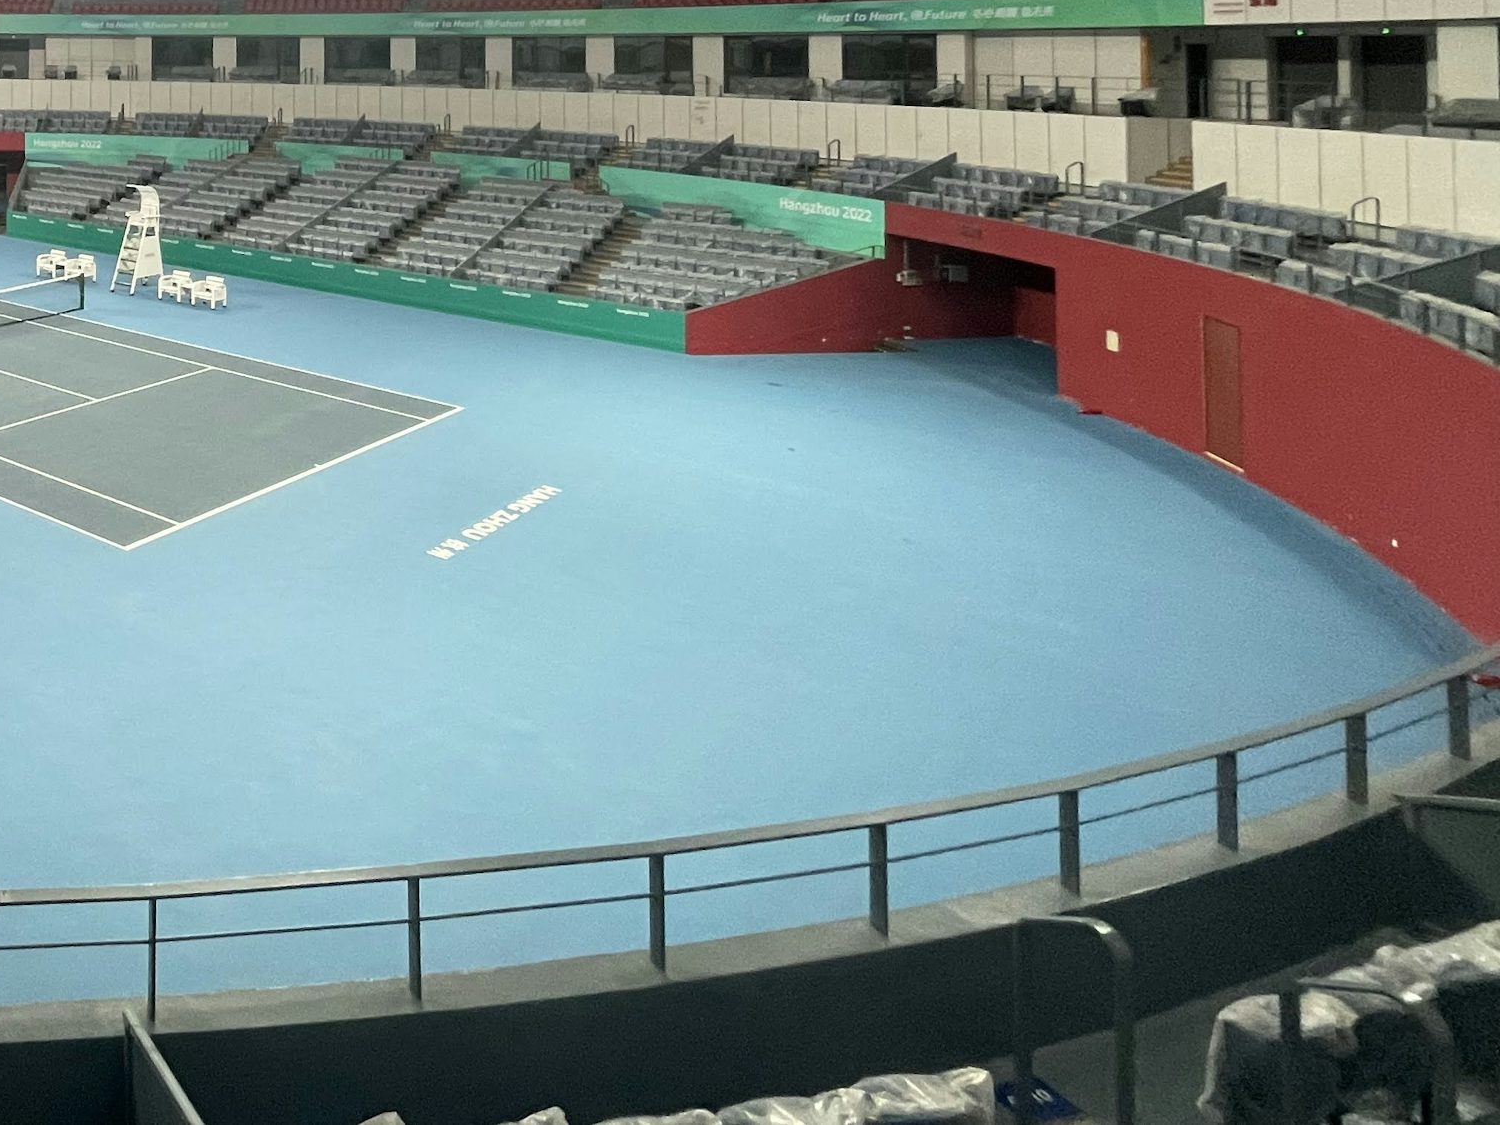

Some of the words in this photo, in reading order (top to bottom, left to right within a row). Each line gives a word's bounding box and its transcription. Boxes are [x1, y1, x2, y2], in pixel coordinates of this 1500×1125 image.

[817, 12, 850, 23] Heart
[854, 11, 866, 22] to
[780, 196, 840, 217] Hangzhou
[842, 206, 873, 223] 2022
